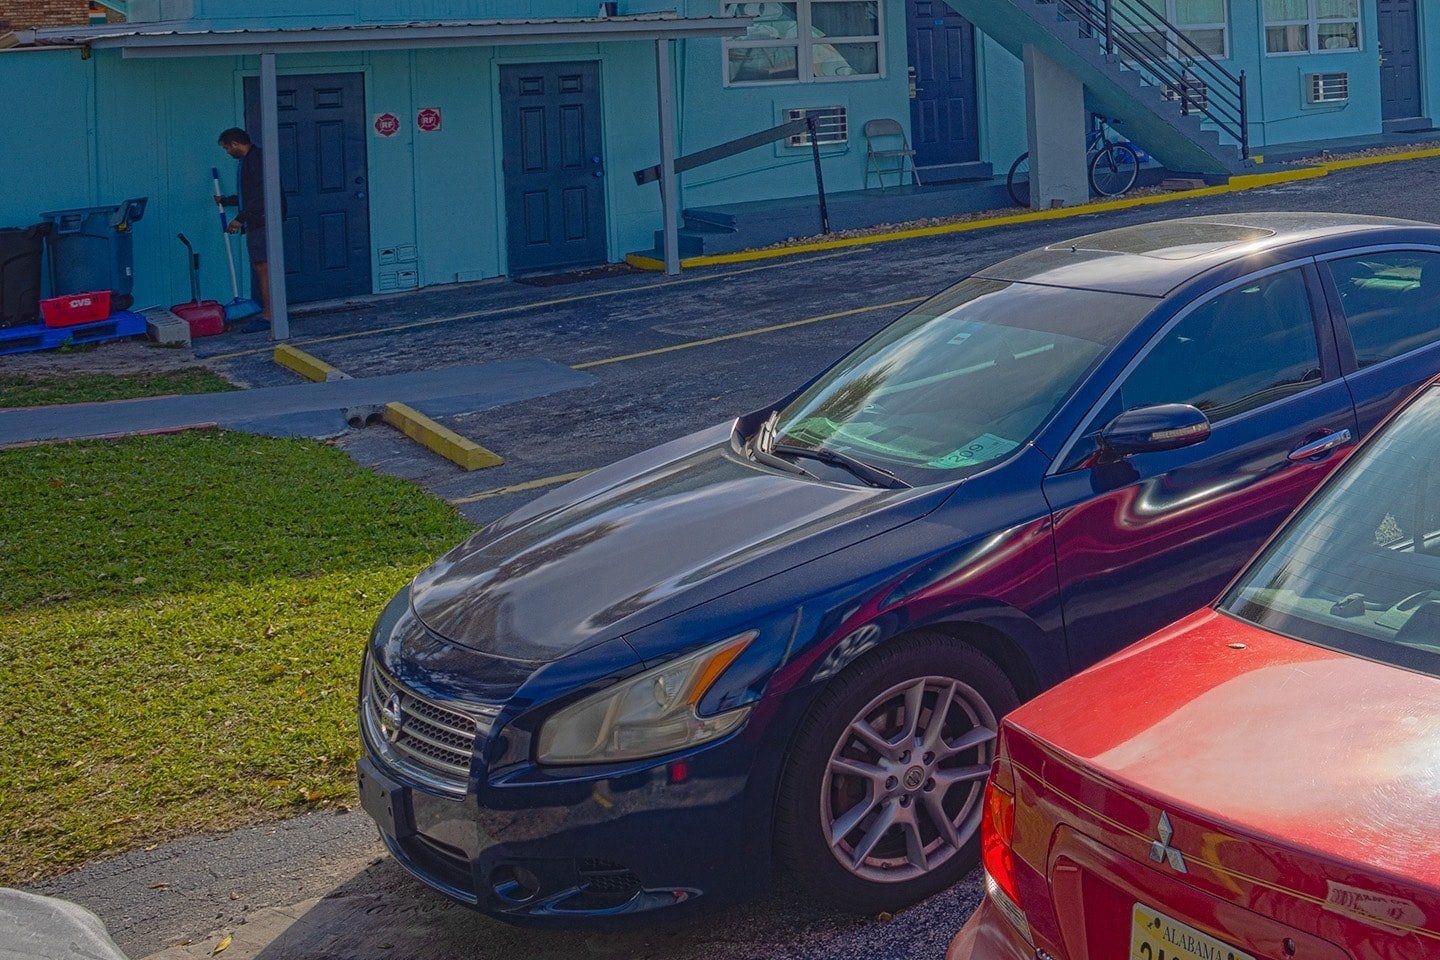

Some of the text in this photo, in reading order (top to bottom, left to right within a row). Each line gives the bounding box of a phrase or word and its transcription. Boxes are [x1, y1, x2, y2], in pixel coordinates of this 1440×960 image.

[381, 121, 394, 129] RF
[69, 298, 91, 308] CVS
[949, 443, 984, 462] 209
[1162, 926, 1222, 960] ALABAMA
